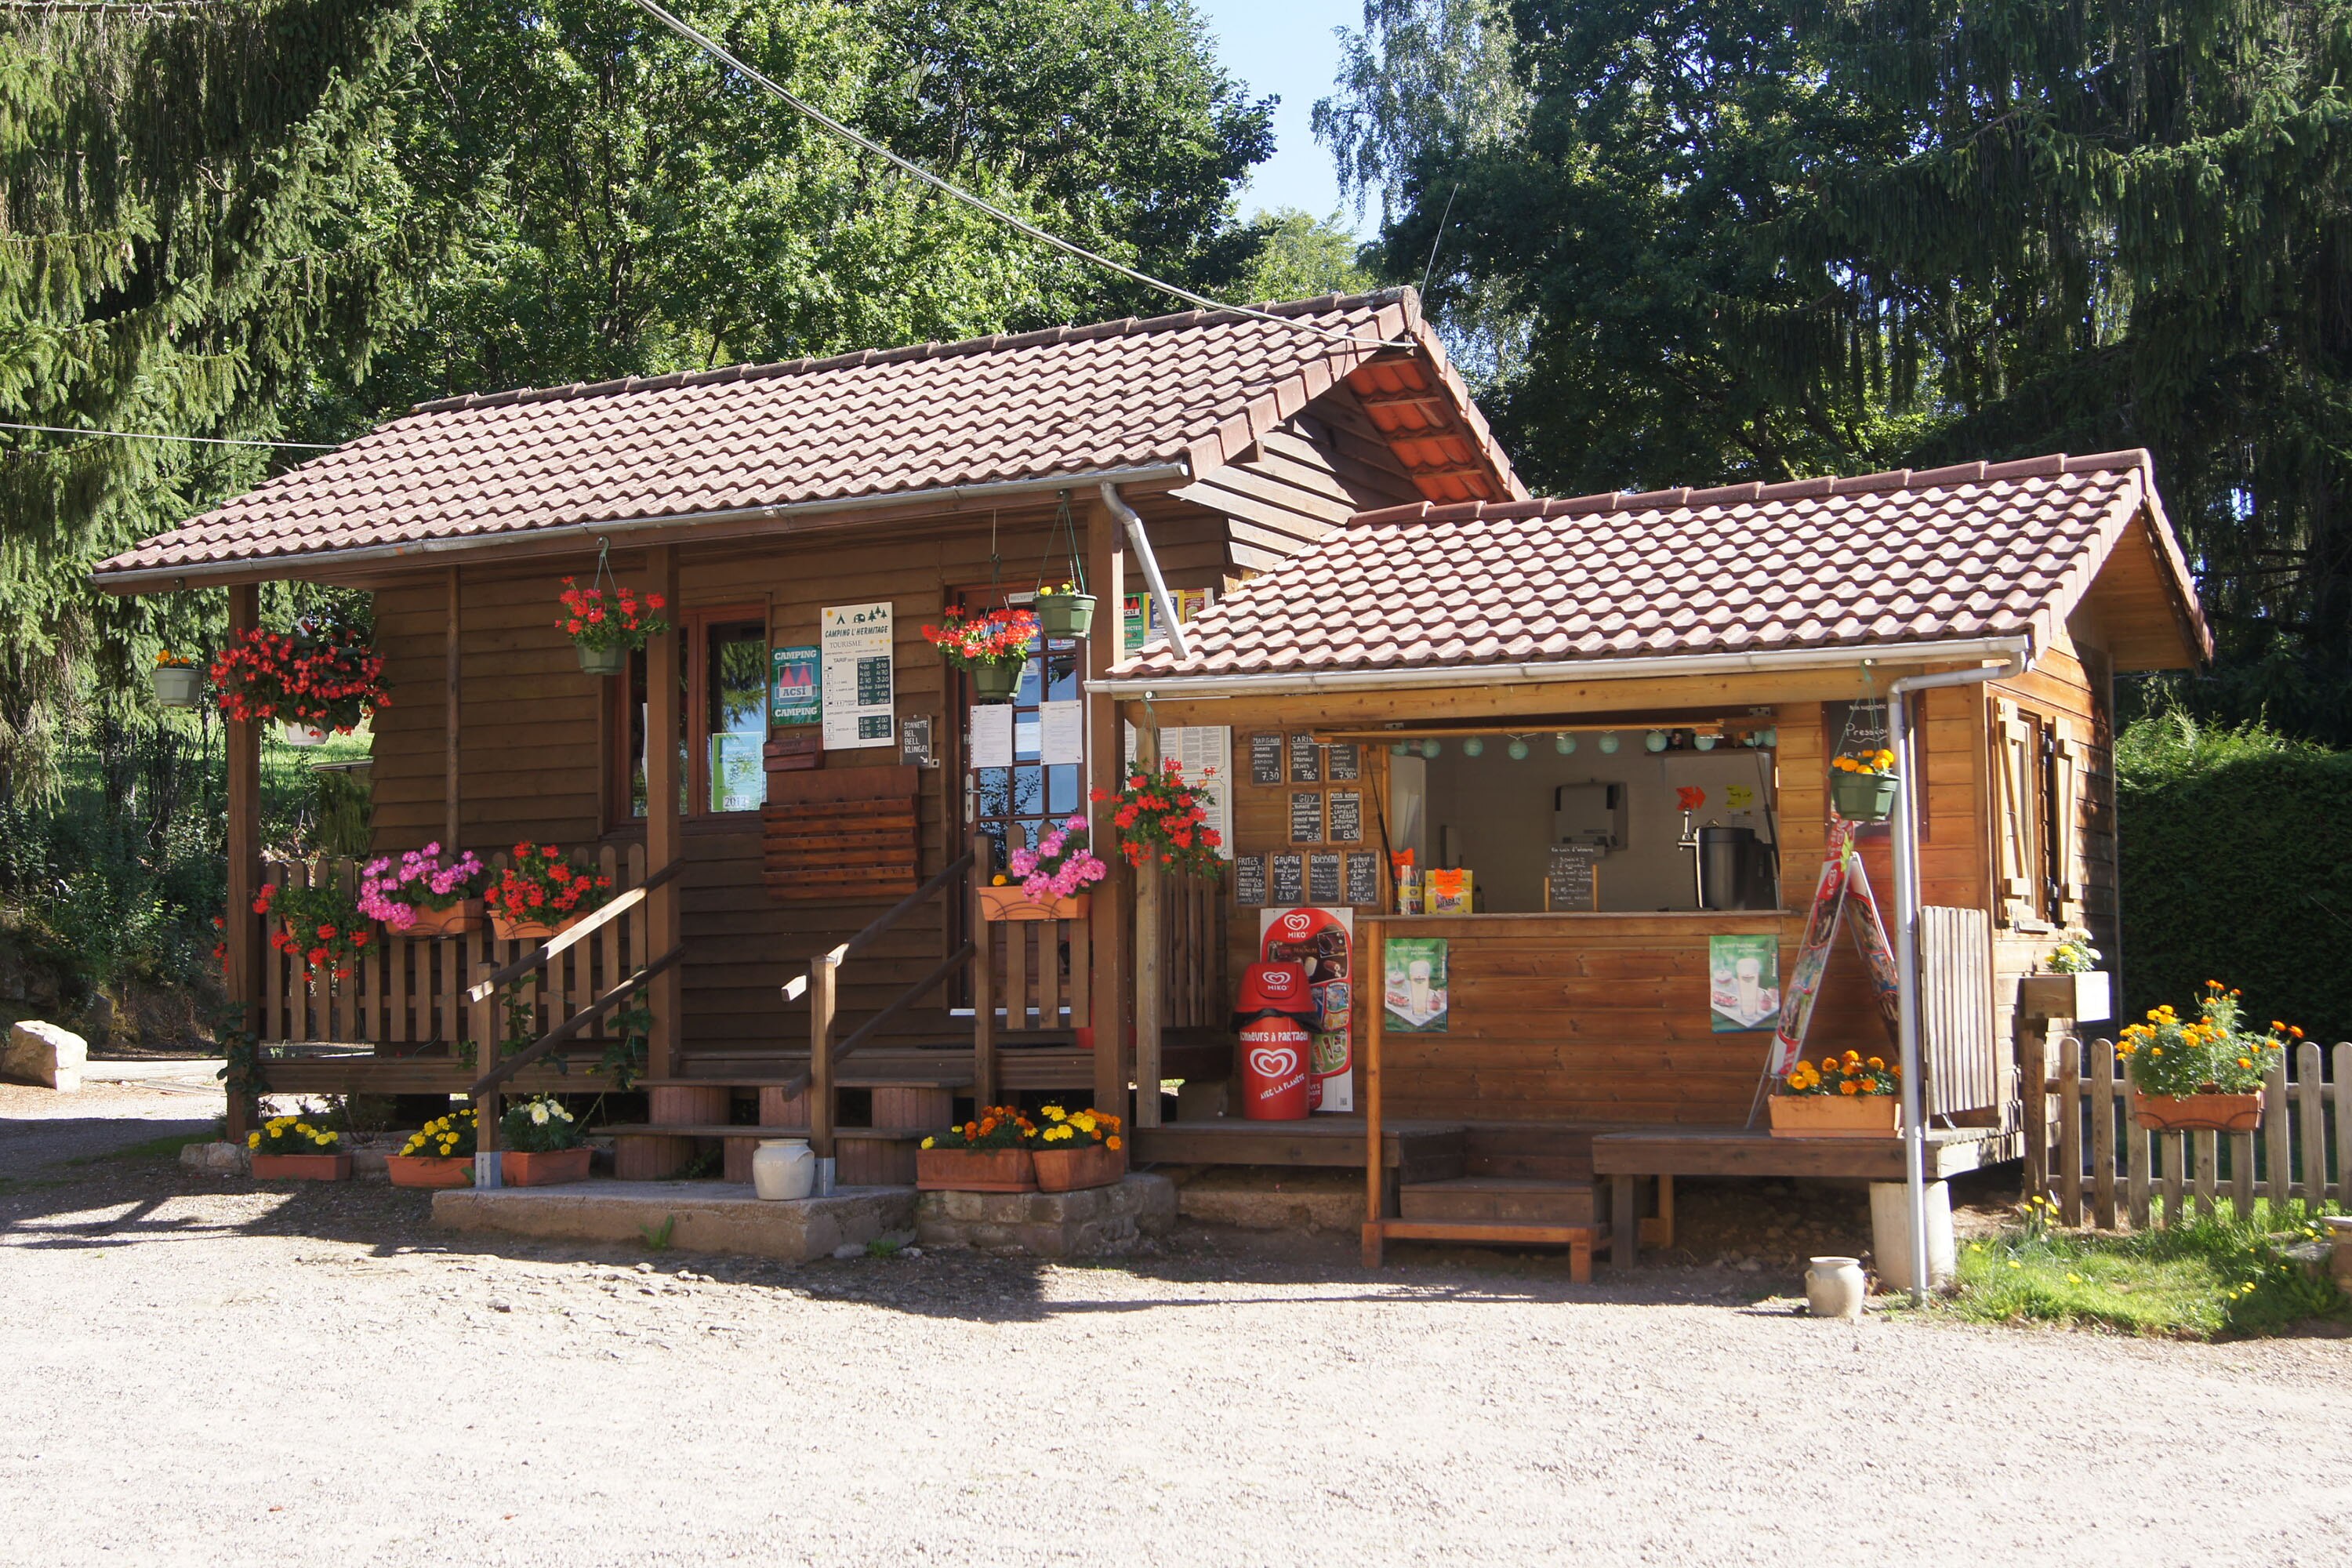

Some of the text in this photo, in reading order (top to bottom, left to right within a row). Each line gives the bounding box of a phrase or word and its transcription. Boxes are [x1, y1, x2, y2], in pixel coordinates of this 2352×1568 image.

[825, 625, 888, 638] CAMPING L'HERMITAGE
[829, 639, 862, 649] TOURISME
[774, 649, 817, 661] CAMPING
[782, 684, 807, 697] ACSI
[774, 706, 818, 717] CAMPING
[903, 720, 928, 729] SONNETTE
[904, 729, 916, 738] BEL
[904, 737, 920, 746] BELL
[904, 745, 929, 753] KLINGEL
[724, 795, 746, 808] 2012
[1298, 793, 1316, 803] GUY
[1273, 855, 1301, 866] GAUFRE
[1260, 1088, 1274, 1100] AVEC
[1274, 1084, 1283, 1094] LA
